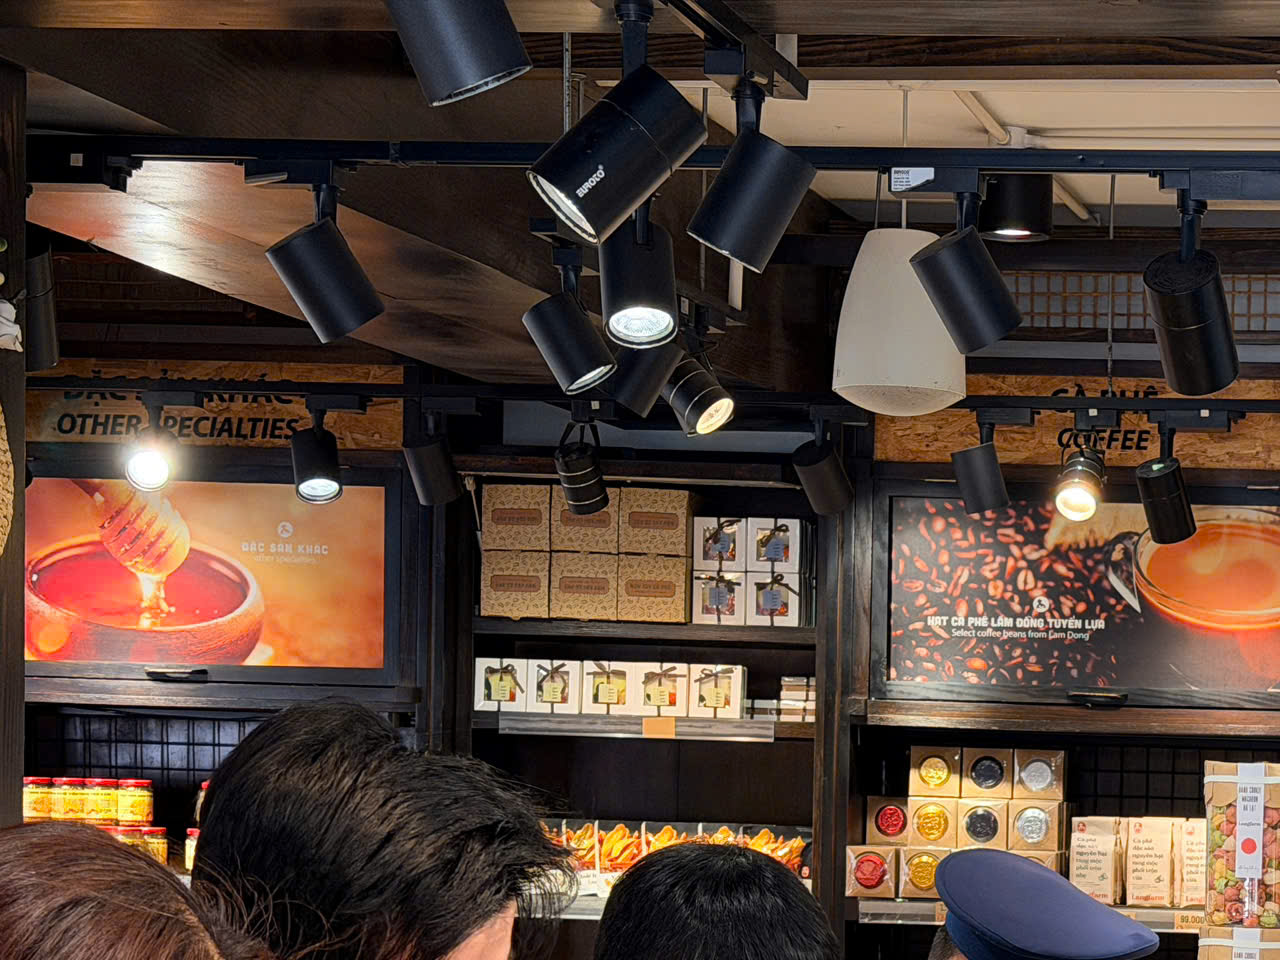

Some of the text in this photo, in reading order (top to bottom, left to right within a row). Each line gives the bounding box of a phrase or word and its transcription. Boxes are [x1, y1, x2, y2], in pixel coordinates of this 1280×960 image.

[57, 414, 141, 436] OTHER
[952, 629, 1090, 642] Select coffee beans from Lam Dong
